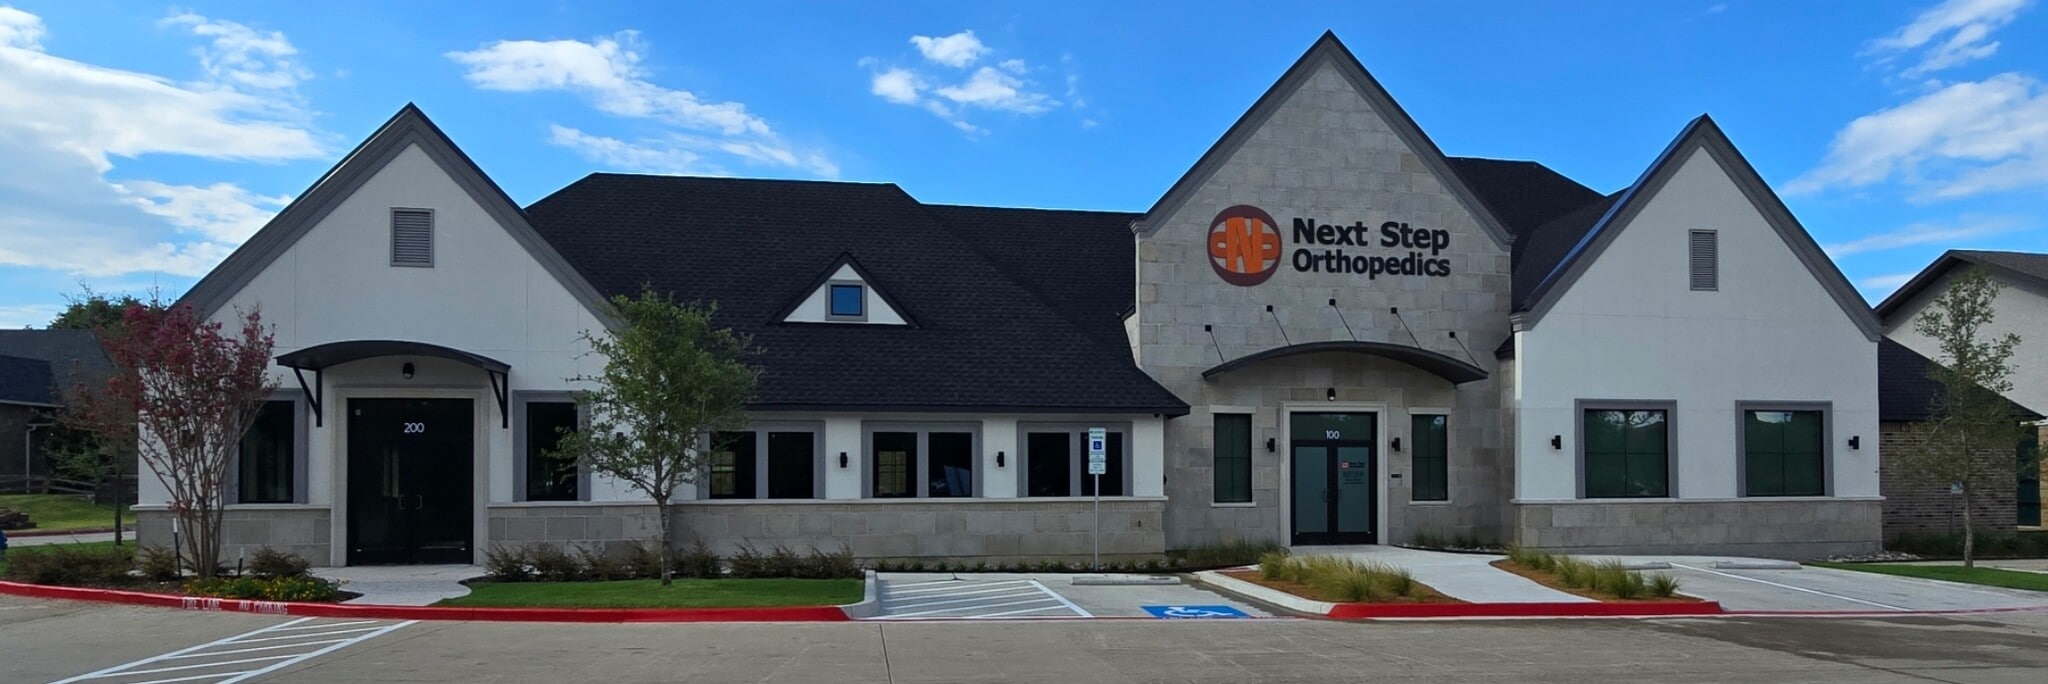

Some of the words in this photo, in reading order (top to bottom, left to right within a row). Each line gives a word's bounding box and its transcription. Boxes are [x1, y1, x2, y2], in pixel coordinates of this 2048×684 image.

[1293, 218, 1368, 246] Next
[1380, 221, 1449, 255] Step
[1292, 249, 1451, 280] Orthopedics
[404, 422, 425, 433] 200
[1326, 429, 1340, 440] 100
[182, 597, 199, 610] FIRE
[202, 598, 222, 611] LANE
[239, 600, 250, 611] NO
[254, 601, 288, 615] PARKING
